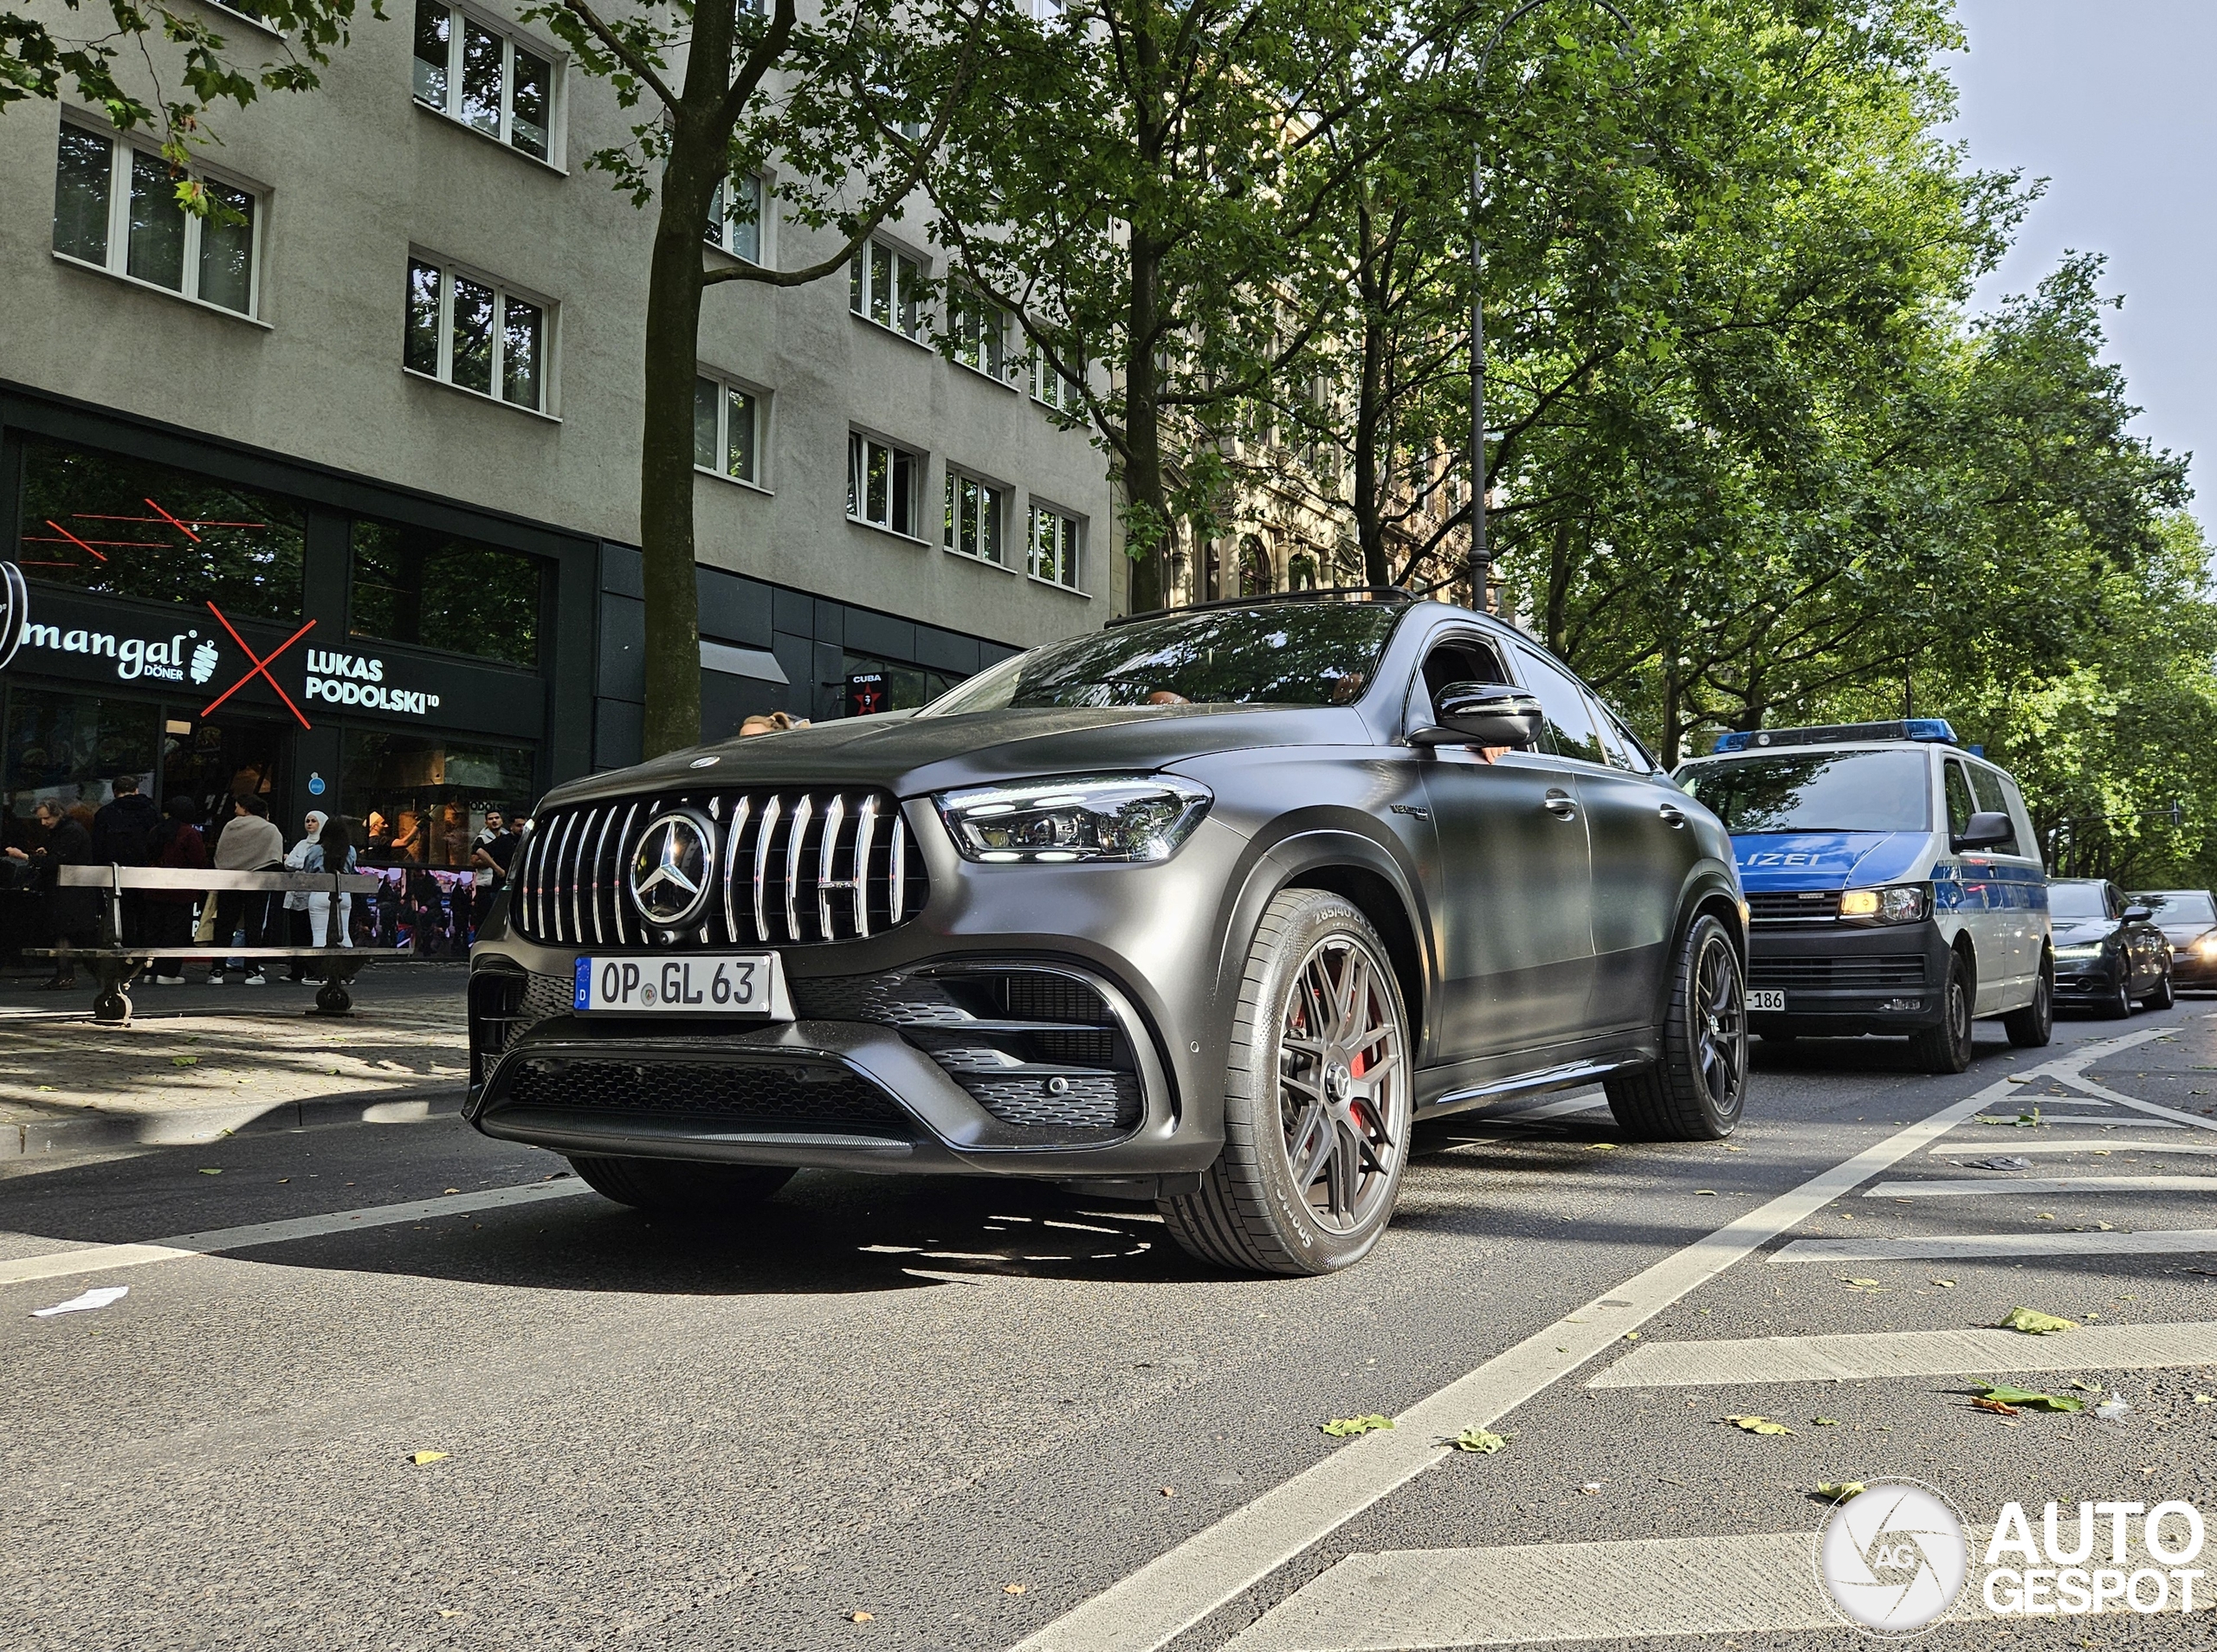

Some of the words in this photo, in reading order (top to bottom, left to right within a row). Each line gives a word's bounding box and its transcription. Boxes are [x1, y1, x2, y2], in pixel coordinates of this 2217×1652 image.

[21, 622, 187, 680] mangal
[144, 663, 184, 681] DÖNER
[307, 649, 384, 682] LUKAS
[853, 674, 882, 683] CUBA
[579, 989, 586, 1001] D
[601, 962, 640, 1003] OP
[661, 962, 703, 1004] GL
[711, 962, 756, 1004] 63
